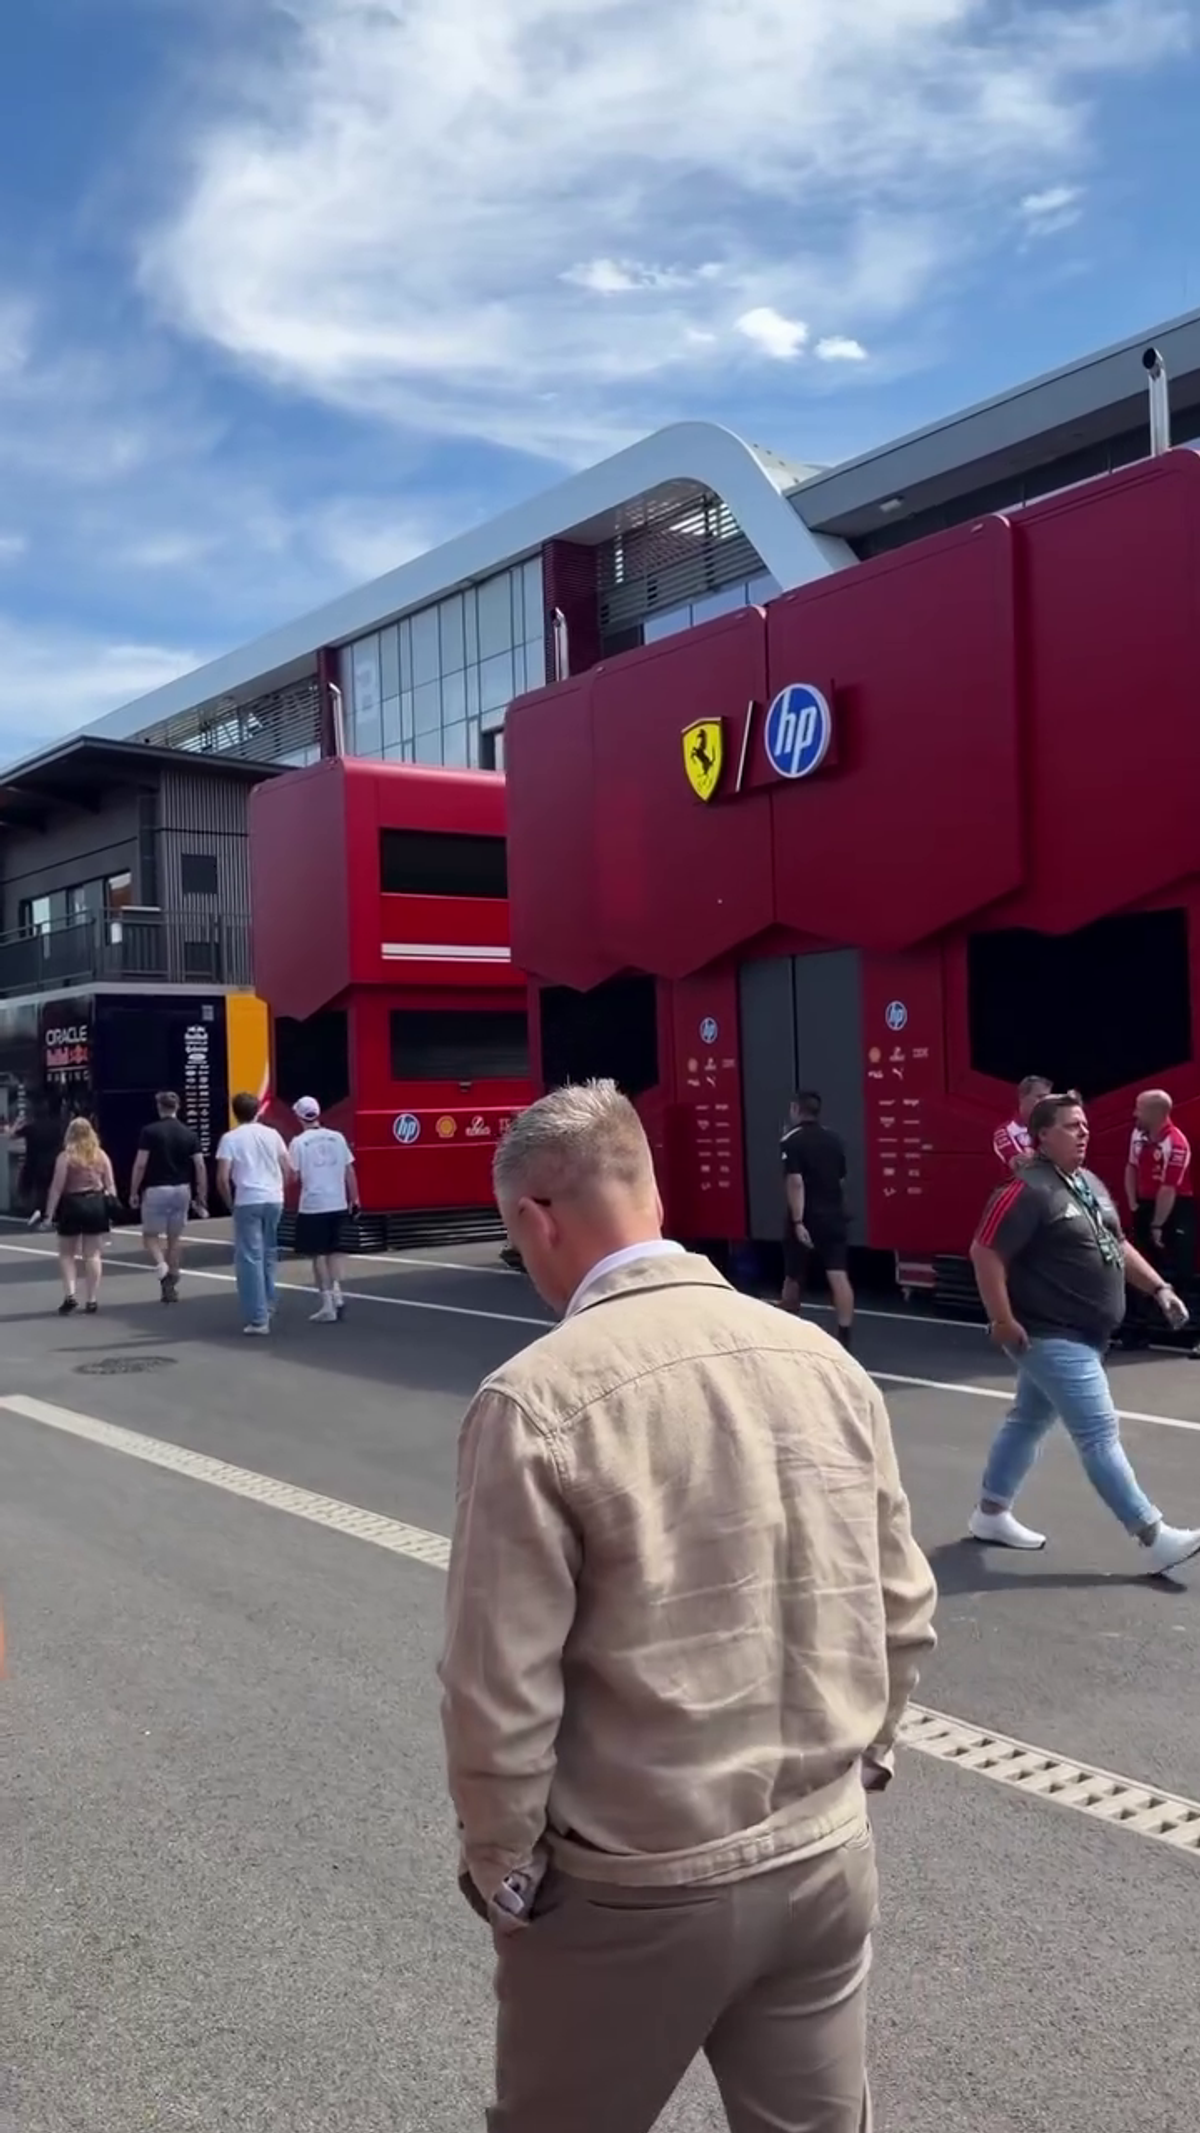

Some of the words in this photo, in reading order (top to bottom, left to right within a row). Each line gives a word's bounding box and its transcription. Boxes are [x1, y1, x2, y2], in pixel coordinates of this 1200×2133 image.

[774, 688, 818, 774] hp
[46, 1025, 88, 1046] ORACLE
[397, 1115, 417, 1142] hp
